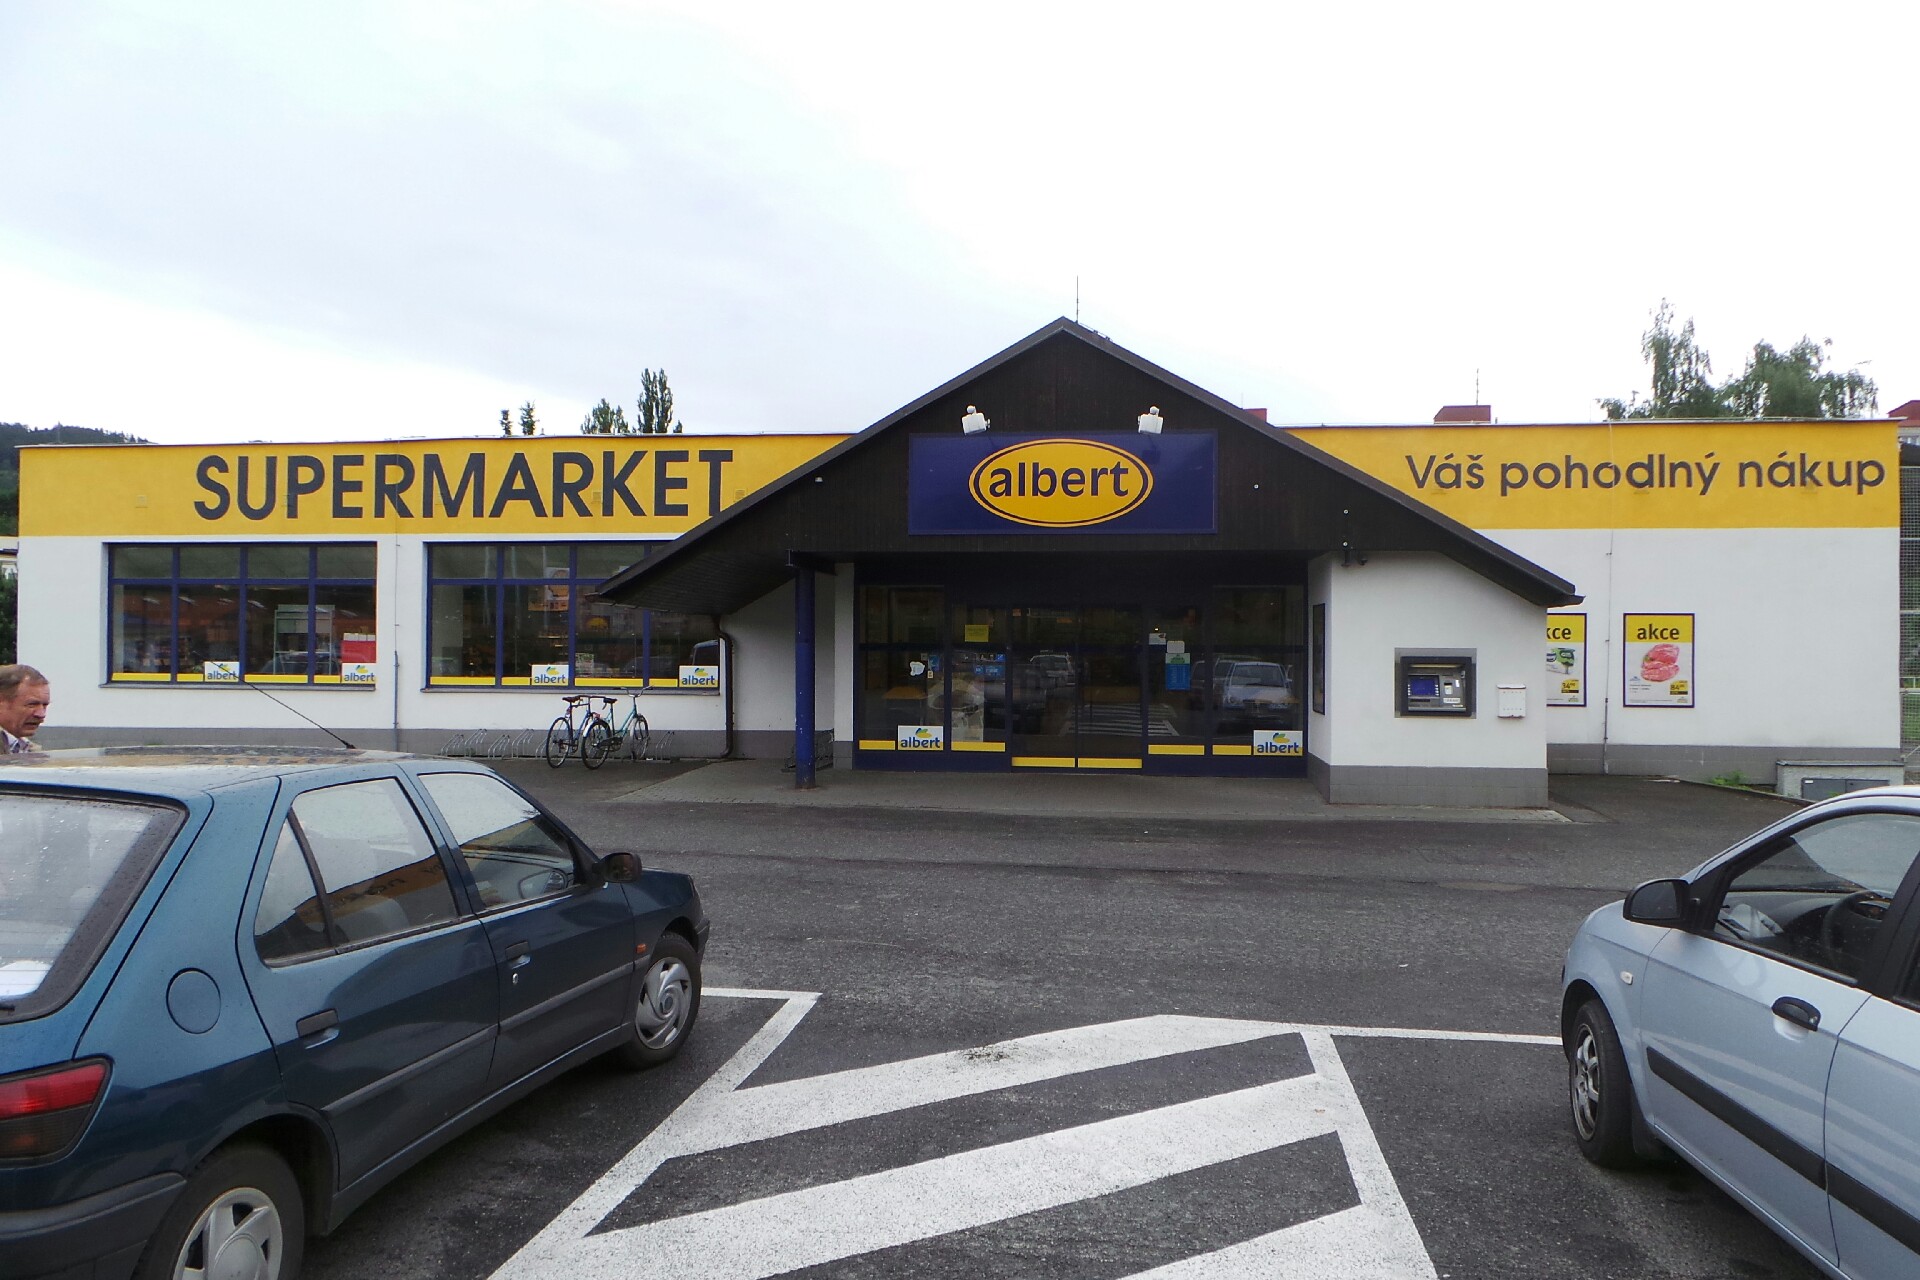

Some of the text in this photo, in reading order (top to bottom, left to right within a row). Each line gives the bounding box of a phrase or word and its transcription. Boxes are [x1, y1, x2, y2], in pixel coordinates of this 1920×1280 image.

[989, 461, 1129, 497] albert
[1405, 450, 1887, 497] Váš pohodlný nákup
[195, 450, 733, 521] SUPERMARKET
[1637, 624, 1680, 640] akce
[207, 671, 237, 680] albert
[344, 672, 375, 682] albert
[534, 673, 566, 684] albert
[681, 674, 716, 685] albert
[900, 737, 940, 748] albert
[1257, 742, 1299, 753] albert
